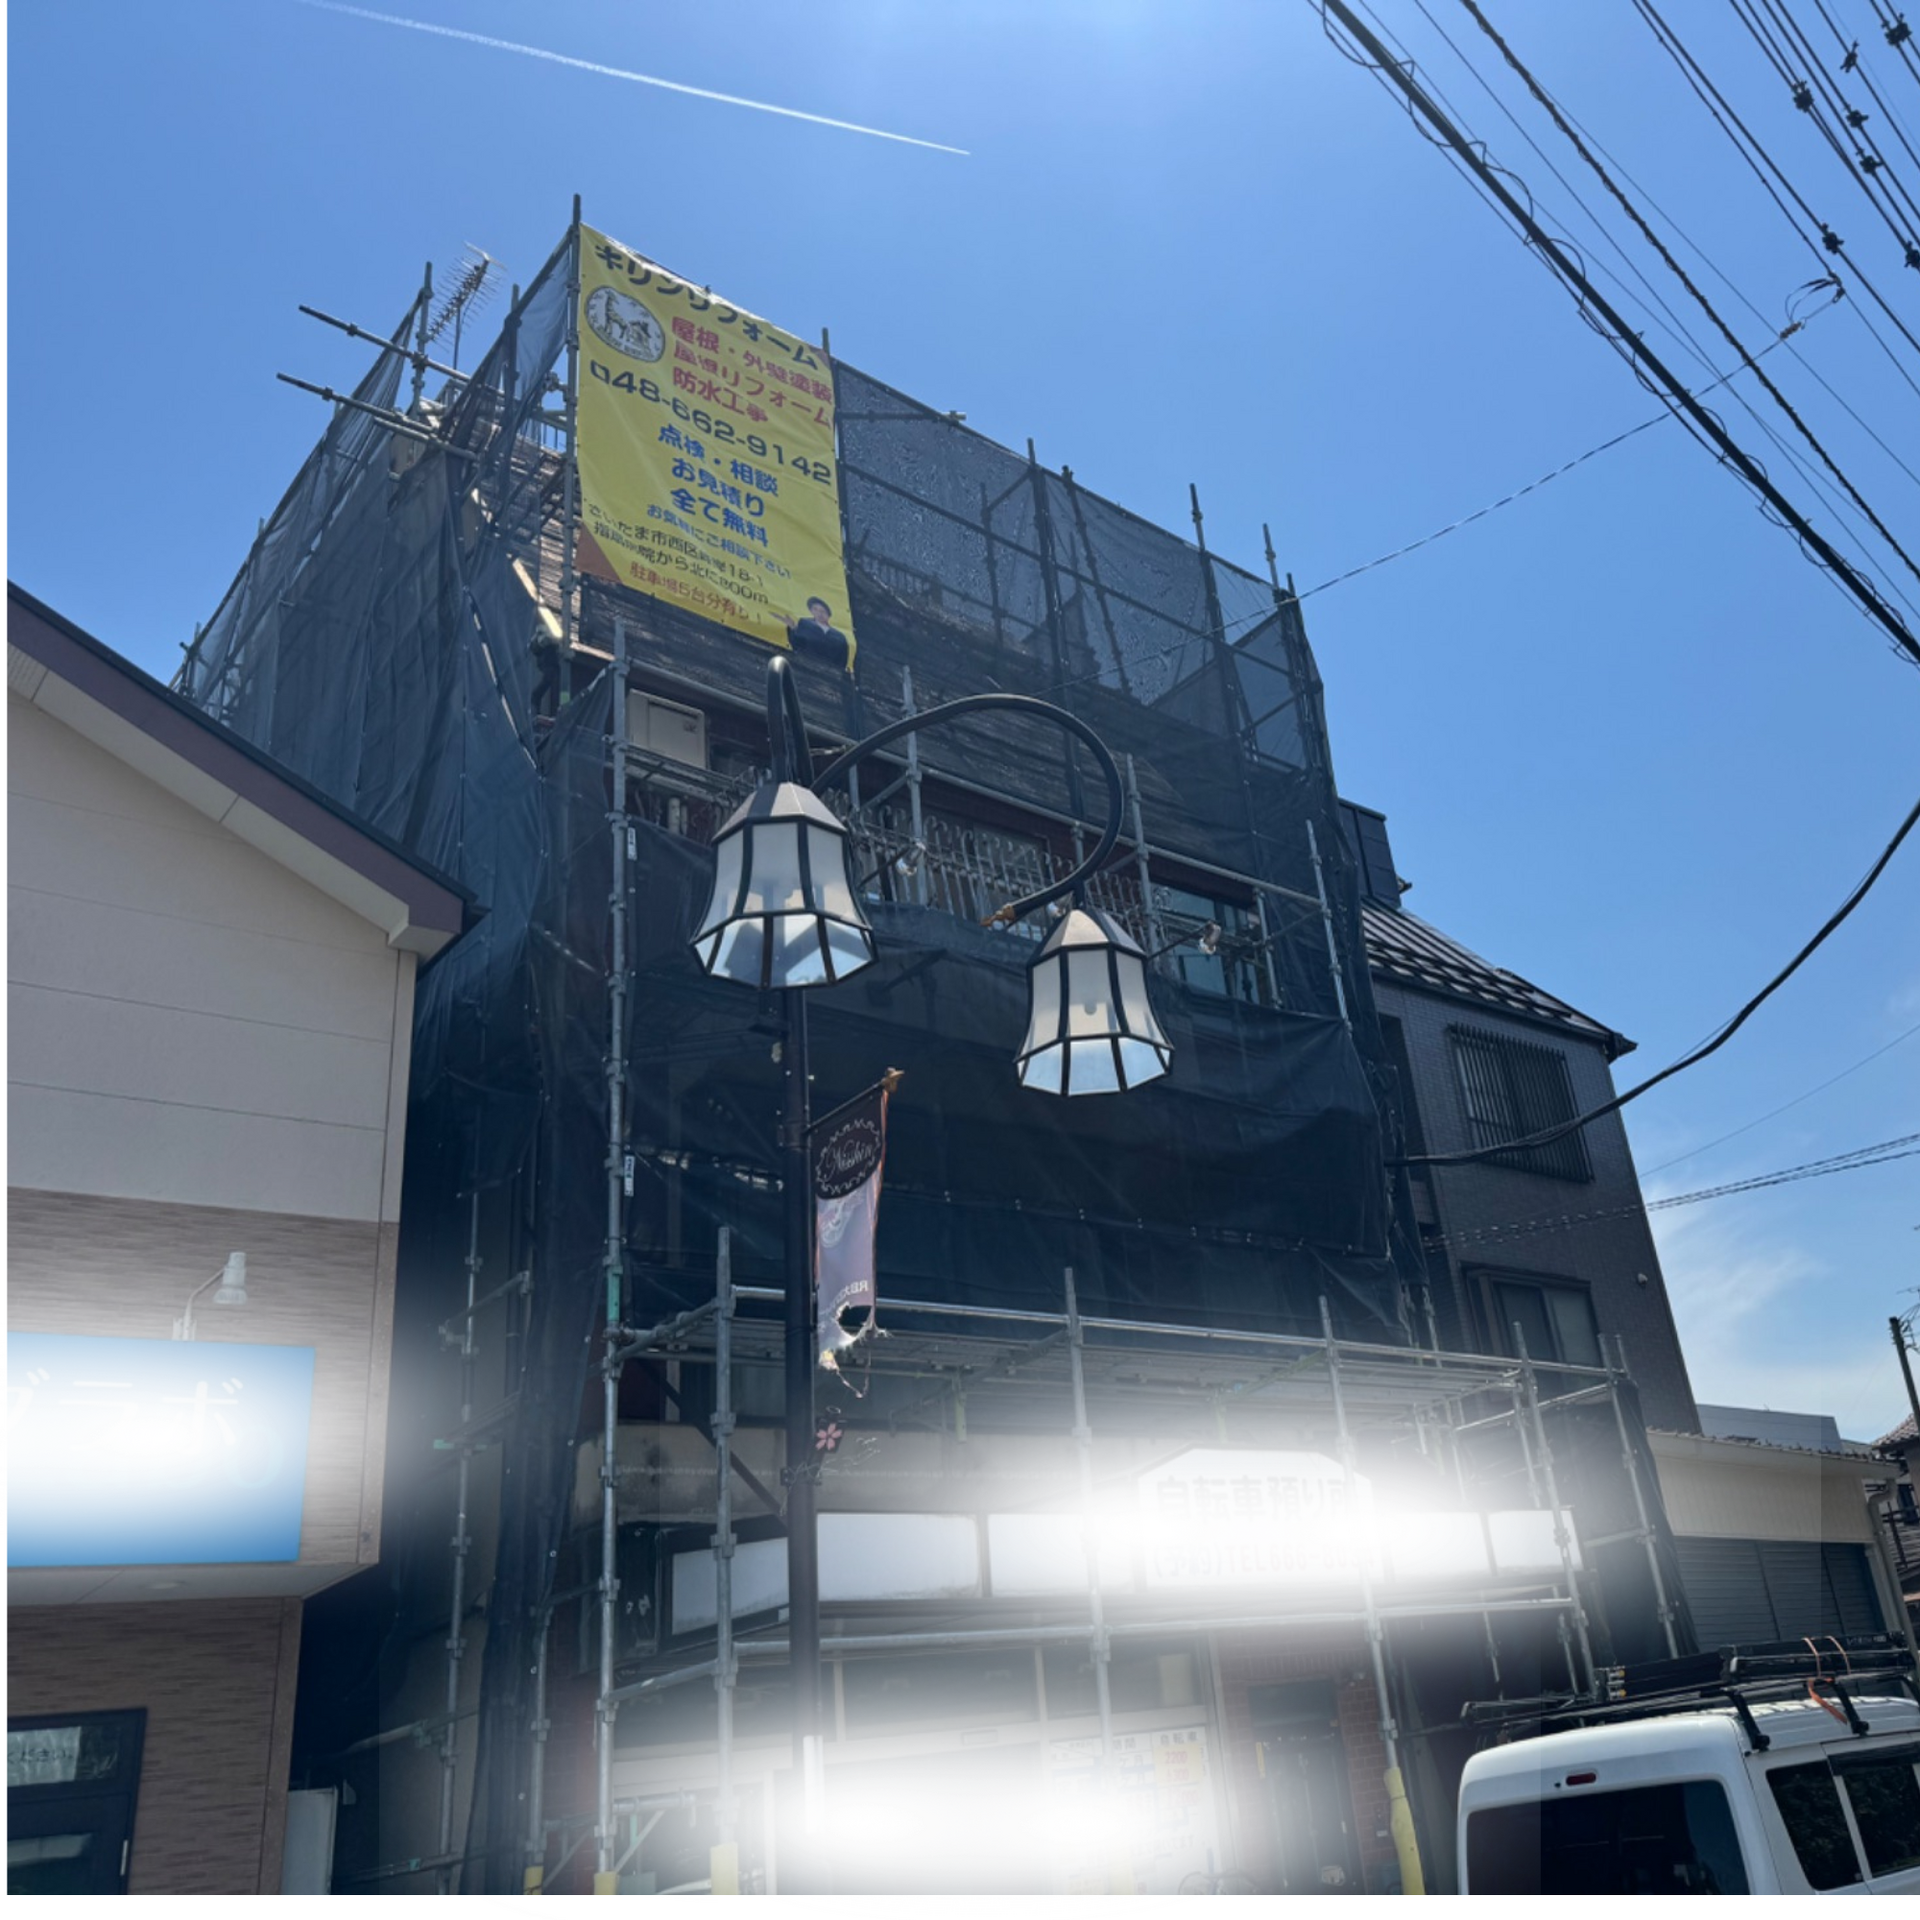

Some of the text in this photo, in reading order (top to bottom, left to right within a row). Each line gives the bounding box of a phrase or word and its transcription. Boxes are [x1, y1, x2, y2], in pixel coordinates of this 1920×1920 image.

[672, 366, 768, 413] 防水工事
[590, 359, 832, 486] 048-662-9142
[657, 423, 778, 497] 点検・相談
[672, 457, 765, 518] お見積り
[671, 487, 768, 547] 全て無料
